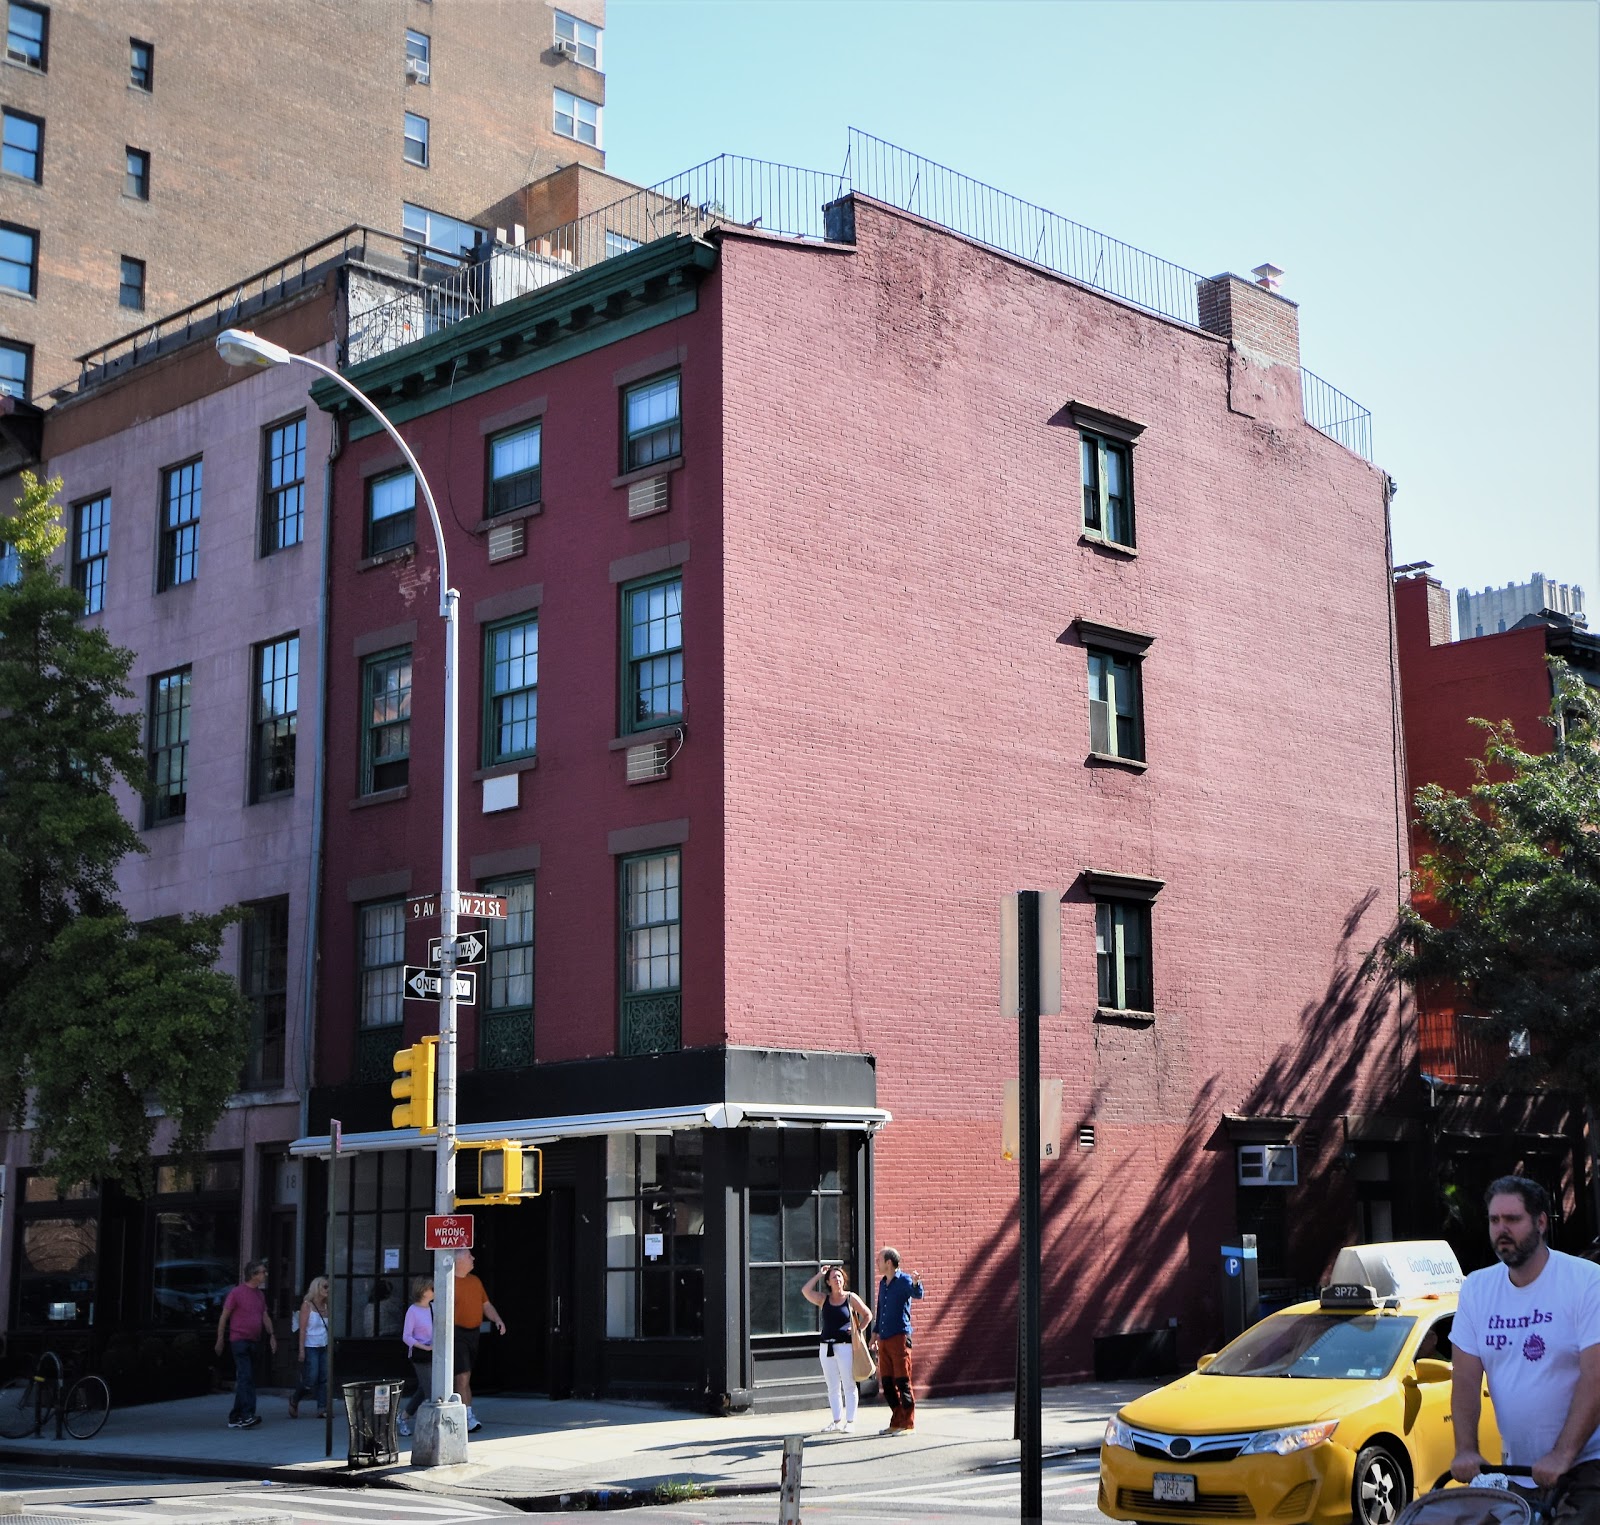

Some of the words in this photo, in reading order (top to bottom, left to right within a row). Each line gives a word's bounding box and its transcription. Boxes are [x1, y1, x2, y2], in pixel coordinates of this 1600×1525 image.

[414, 903, 420, 918] 9
[423, 902, 434, 917] Av
[460, 898, 471, 914] W
[474, 900, 485, 915] 21
[489, 901, 500, 917] St
[460, 942, 477, 955] WAY
[416, 978, 436, 990] ONE
[434, 1227, 465, 1237] WRONG
[440, 1236, 459, 1246] WAY
[1230, 1258, 1238, 1274] P
[1334, 1286, 1358, 1297] 3P72
[1485, 1334, 1513, 1351] up.
